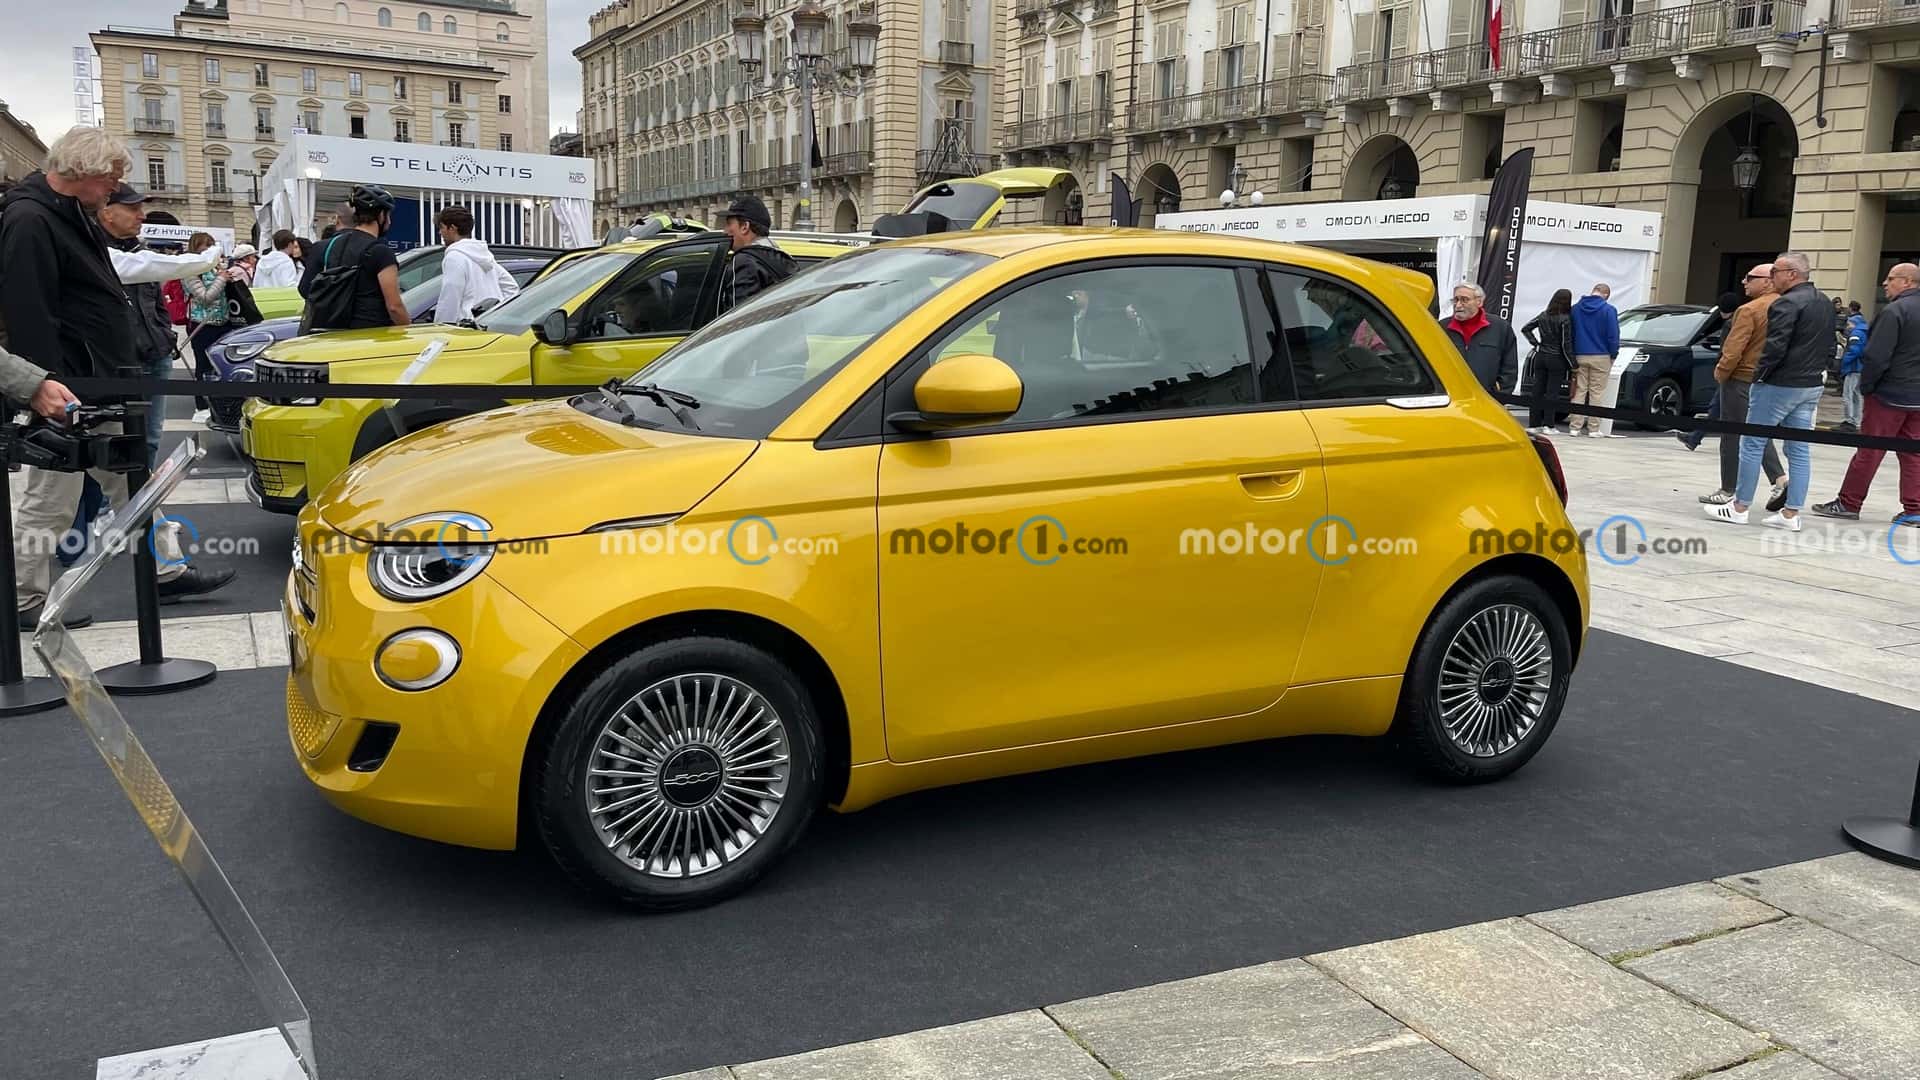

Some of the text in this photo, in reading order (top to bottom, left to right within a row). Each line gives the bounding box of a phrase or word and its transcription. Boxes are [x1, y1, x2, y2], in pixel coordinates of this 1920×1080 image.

[370, 154, 533, 180] STELLANTIS
[1221, 220, 1259, 231] JAECOO
[1325, 212, 1430, 226] OMODA JAECOO
[1526, 215, 1623, 233] MODA JAECOO
[161, 228, 193, 236] HYUND
[1500, 206, 1521, 321] ODA JAECOO
